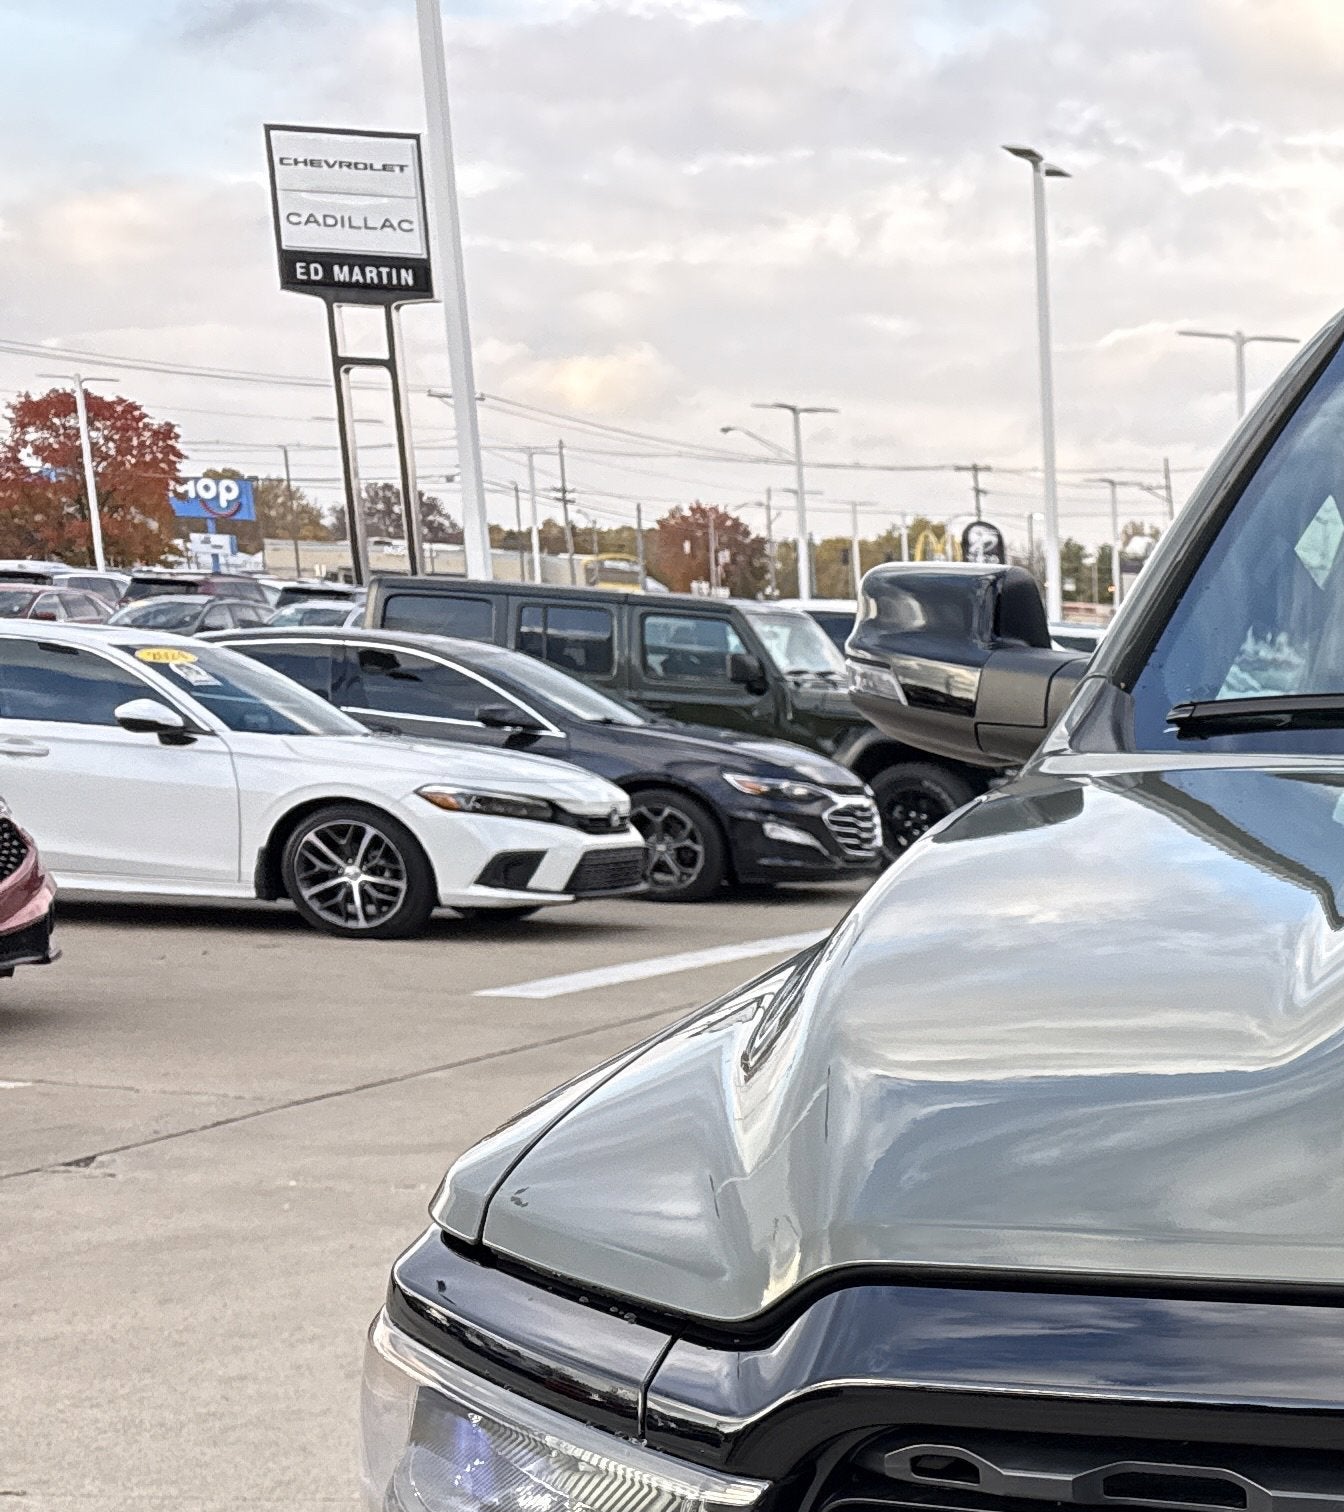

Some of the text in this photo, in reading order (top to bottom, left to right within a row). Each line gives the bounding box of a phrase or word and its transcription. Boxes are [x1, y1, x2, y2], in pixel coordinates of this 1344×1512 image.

[279, 157, 409, 174] CHEVROLET
[286, 212, 415, 233] CADILLAC
[295, 262, 414, 287] ED MARTIN
